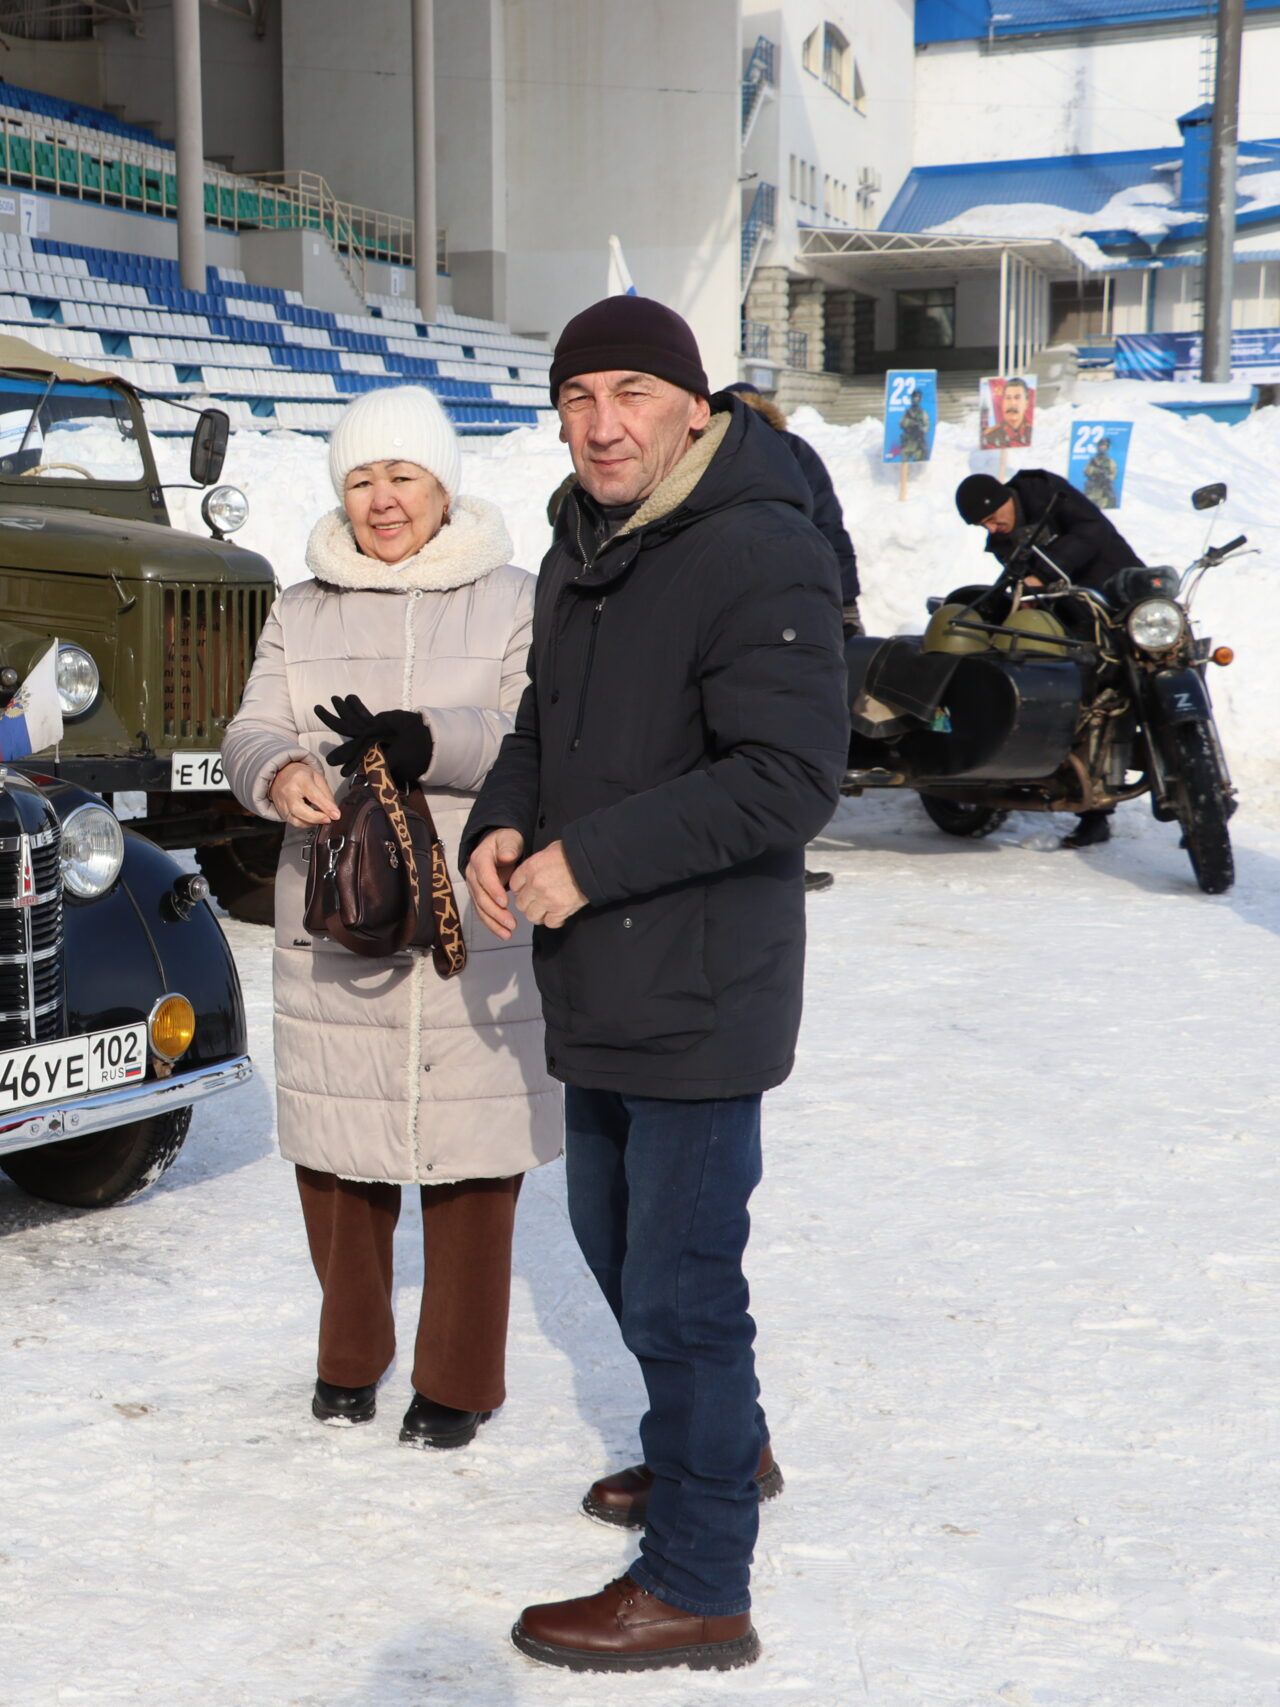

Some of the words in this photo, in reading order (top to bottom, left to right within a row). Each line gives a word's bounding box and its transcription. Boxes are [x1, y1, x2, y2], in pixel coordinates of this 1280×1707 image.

[25, 211, 32, 233] 7
[180, 758, 224, 786] Е16
[92, 1031, 138, 1069] 102
[101, 1067, 125, 1083] RUS
